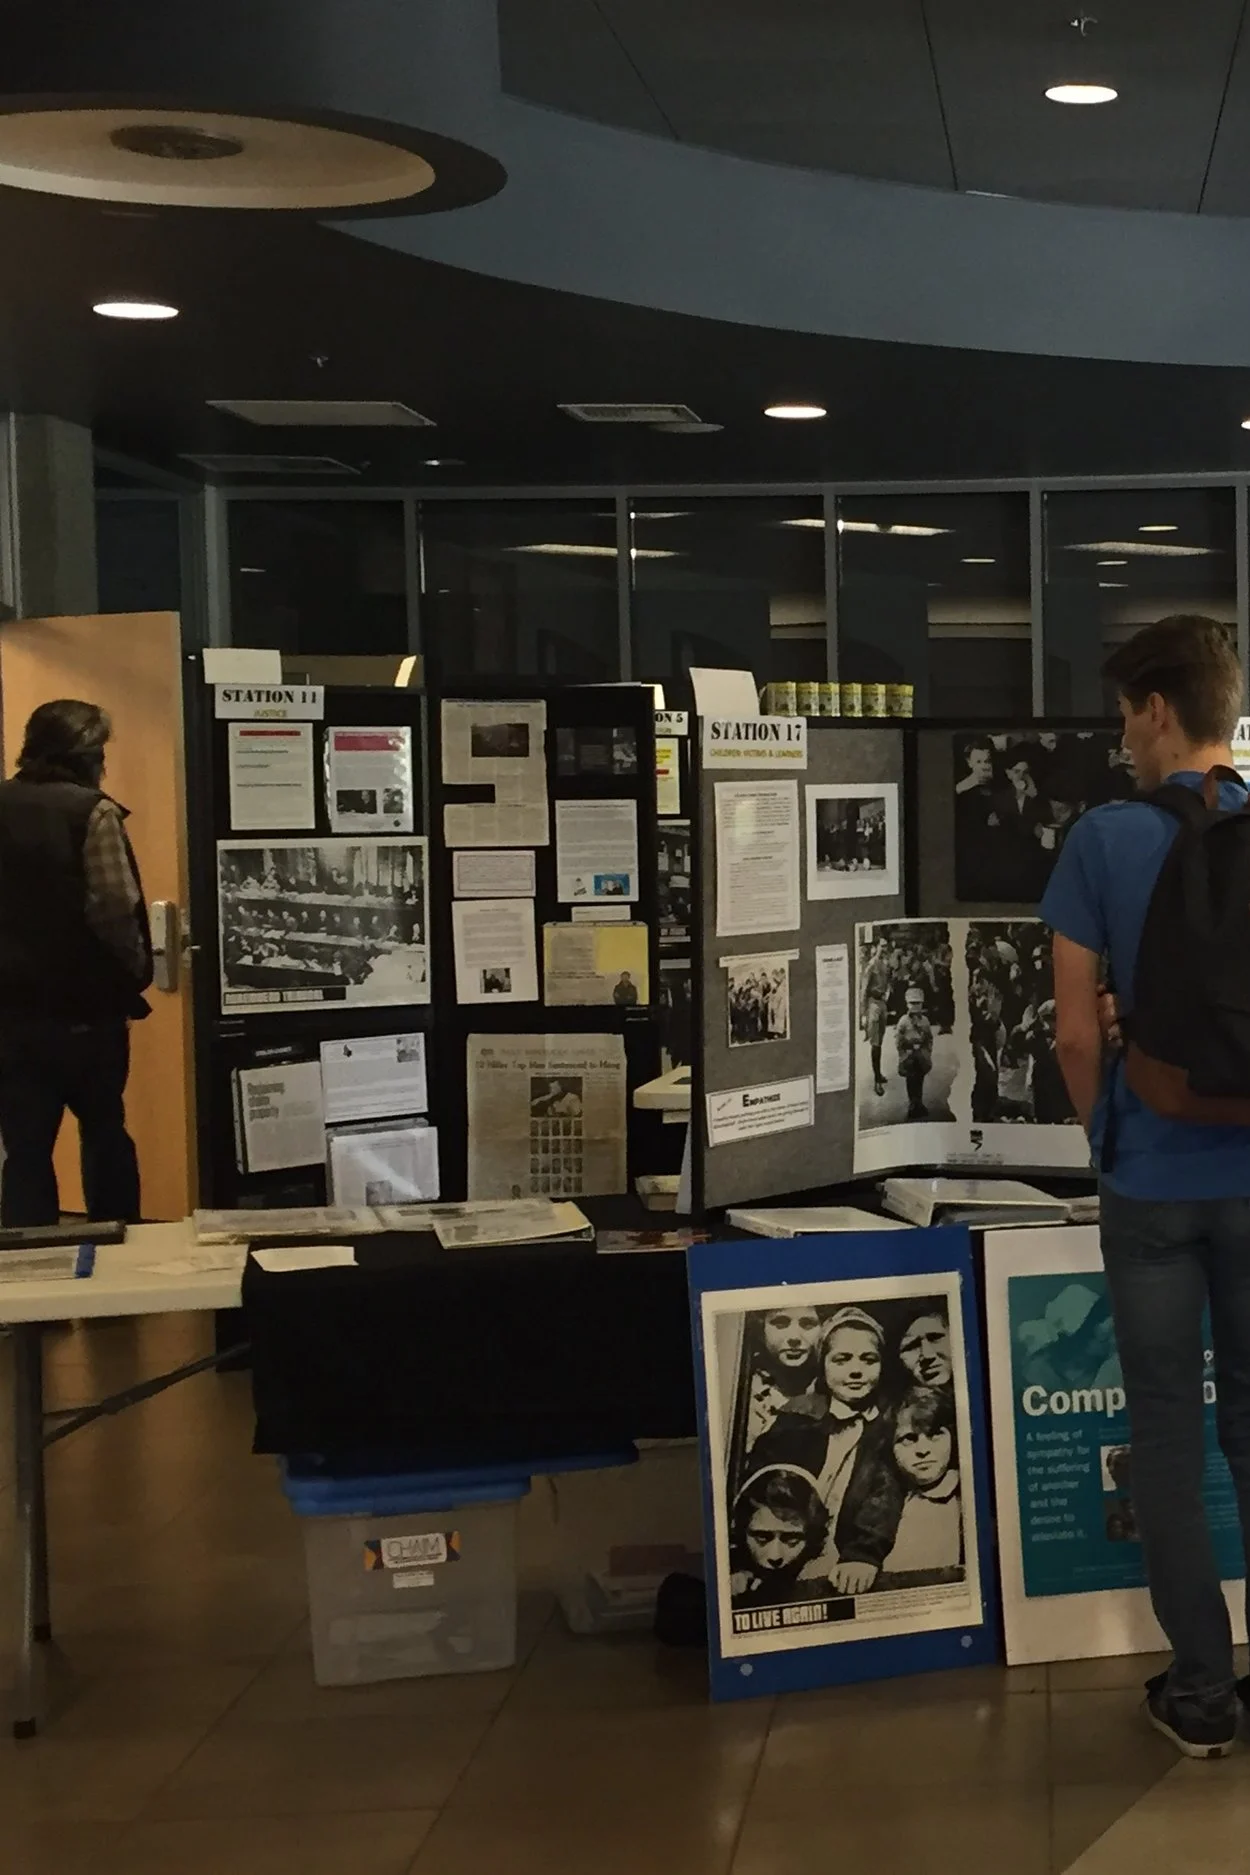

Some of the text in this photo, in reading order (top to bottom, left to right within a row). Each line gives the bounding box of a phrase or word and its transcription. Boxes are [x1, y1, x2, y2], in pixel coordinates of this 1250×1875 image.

[222, 689, 294, 704] STATION
[676, 713, 684, 723] 5
[711, 721, 801, 741] STATION 17
[734, 1614, 750, 1632] TO
[752, 1609, 781, 1629] LIVE
